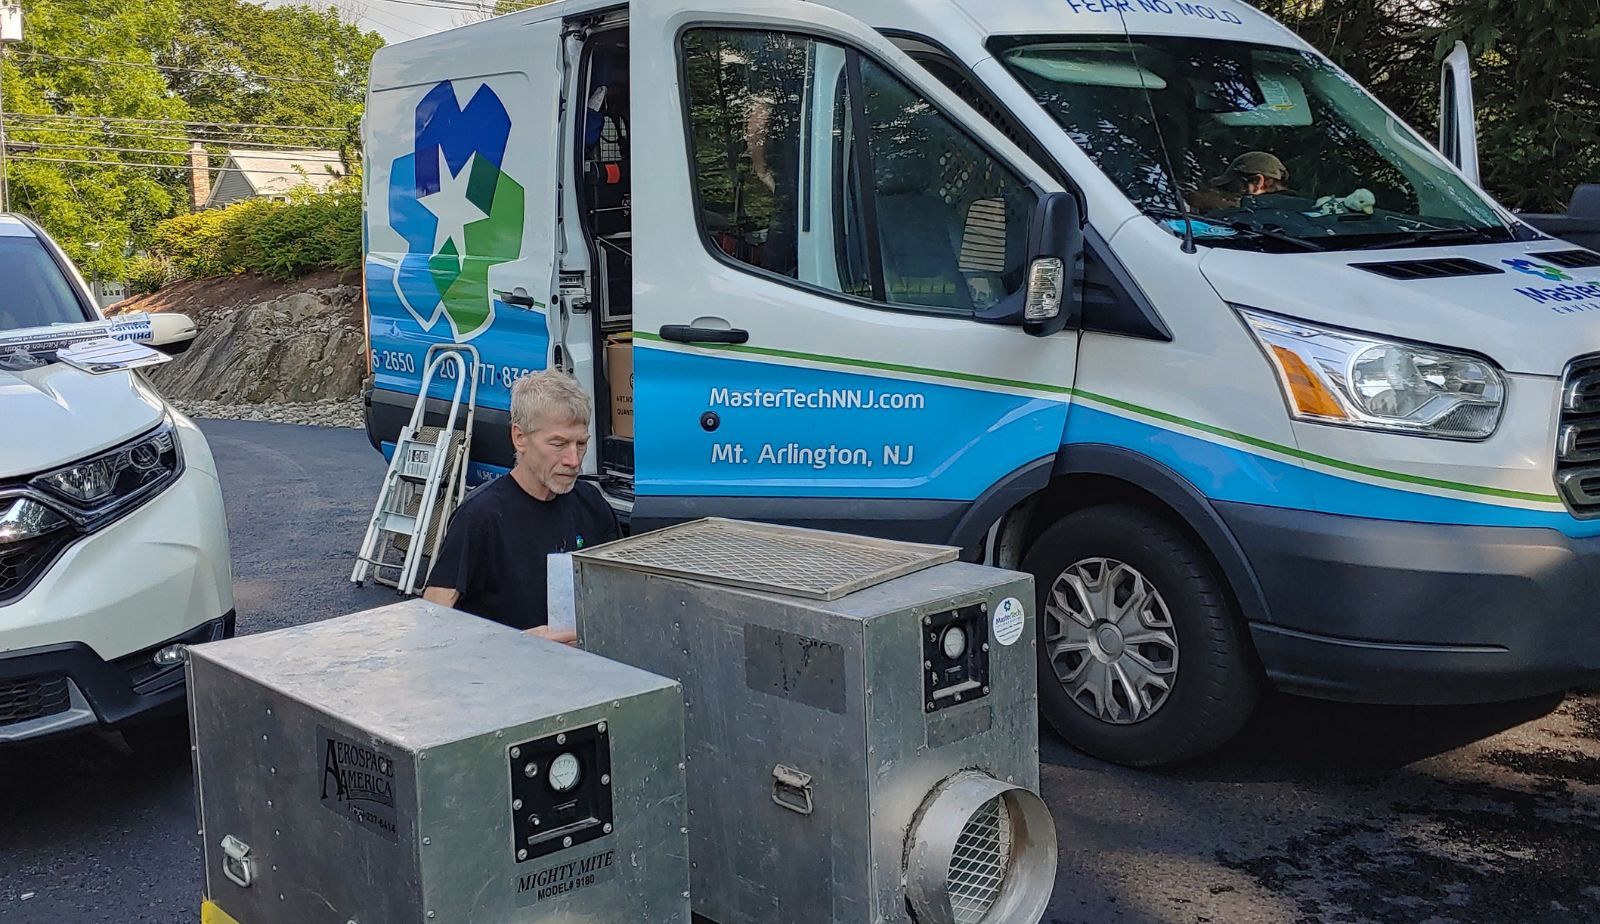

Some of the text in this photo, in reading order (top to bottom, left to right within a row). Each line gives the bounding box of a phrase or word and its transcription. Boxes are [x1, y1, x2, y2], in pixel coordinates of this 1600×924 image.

[1066, 0, 1242, 25] FEAR NO MOLD
[111, 331, 151, 342] PHILIPS
[708, 387, 925, 409] MasterTechNNJ.com
[711, 443, 914, 470] Mt. Arlington, NJ
[321, 739, 394, 801] AEROSPACE
[338, 769, 394, 802] AMERICA
[517, 851, 614, 893] MIGHTY MITE
[537, 874, 595, 901] MODEL# 9180
